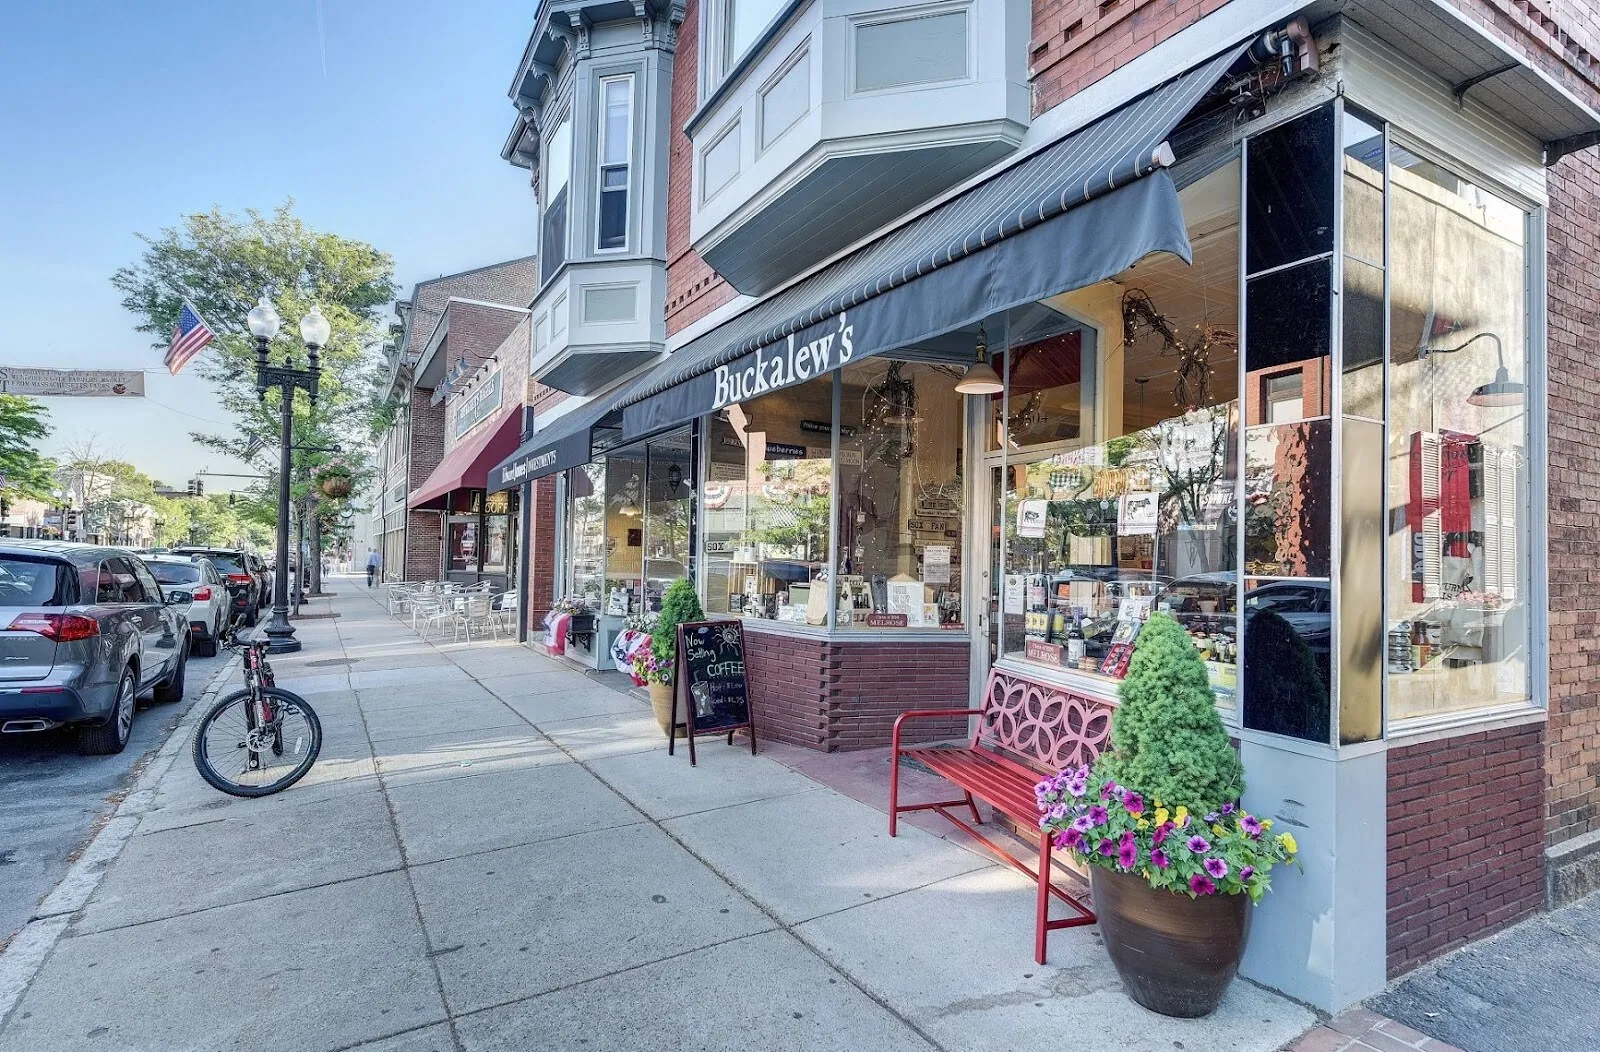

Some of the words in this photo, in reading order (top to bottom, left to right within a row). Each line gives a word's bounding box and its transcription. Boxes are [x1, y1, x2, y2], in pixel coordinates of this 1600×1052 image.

[712, 312, 854, 410] Buckalew's
[767, 446, 804, 456] ueberries
[909, 519, 924, 530] SOX
[930, 521, 945, 531] FAN
[707, 542, 724, 551] SOX
[685, 632, 705, 648] Now
[687, 648, 716, 662] Selling
[1028, 648, 1058, 662] MELROSE
[707, 661, 745, 677] COFFEE
